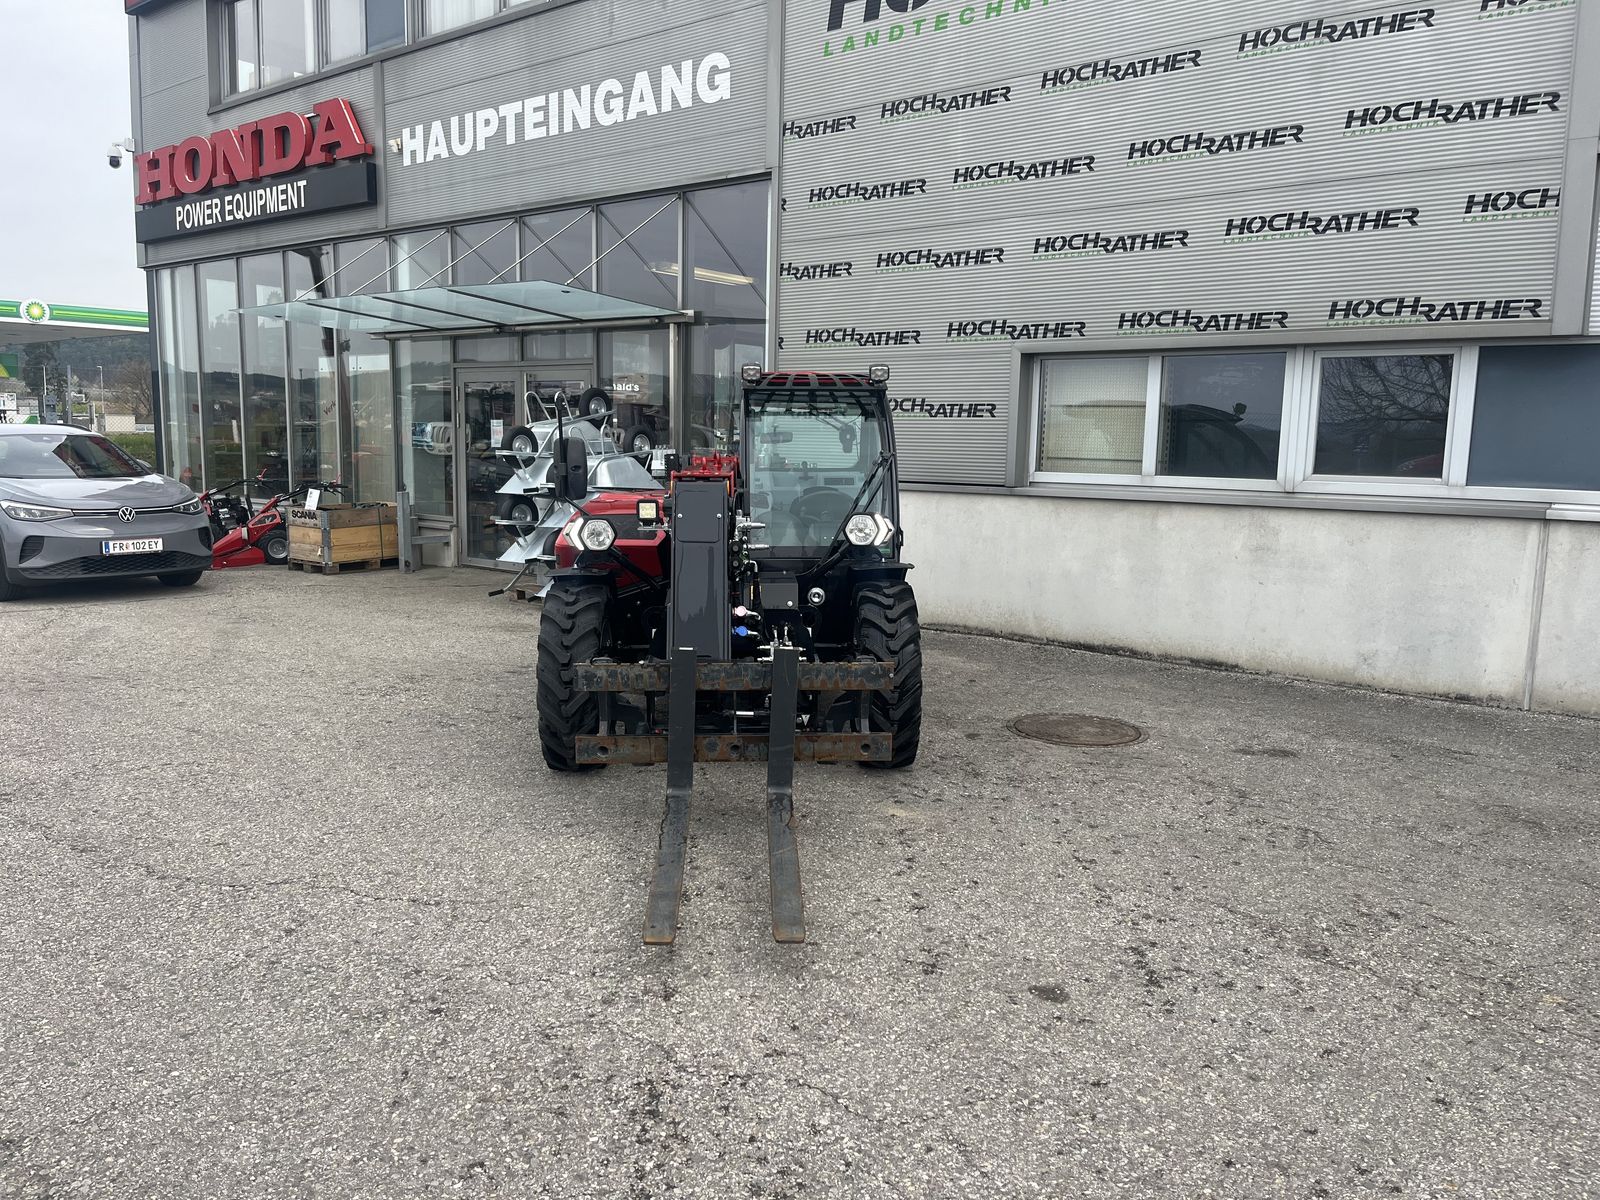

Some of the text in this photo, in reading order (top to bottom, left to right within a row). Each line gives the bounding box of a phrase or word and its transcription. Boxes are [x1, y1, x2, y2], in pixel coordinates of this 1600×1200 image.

[823, 0, 1060, 57] LANDTECHN
[1238, 8, 1435, 52] HOCHRATHER
[1041, 50, 1201, 90] HOCHRATHER
[402, 52, 731, 166] HAUPTEINGANG
[881, 86, 1011, 119] HOCHRATHER
[1344, 92, 1561, 129] HOCHRATHER
[1343, 119, 1440, 137] LANDTECHNIK
[135, 98, 374, 205] HONDA
[1128, 125, 1304, 159] HOCHRATHER
[953, 156, 1095, 183] HOCHRATHER
[809, 179, 926, 201] HOCHRATHER
[176, 180, 307, 230] POWER EQUIPMENT
[1225, 208, 1419, 236] HOCHRATHER
[1034, 230, 1189, 254] HOCHRATHER
[877, 248, 1004, 268] HOCHRATHER
[1118, 310, 1288, 332] HOCHRATHER
[1328, 297, 1542, 322] HOCHRATHER
[806, 328, 921, 346] HOCHRATHER
[947, 319, 1086, 340] HOCHRATHER
[291, 509, 318, 521] SCANIA
[112, 542, 125, 551] FR
